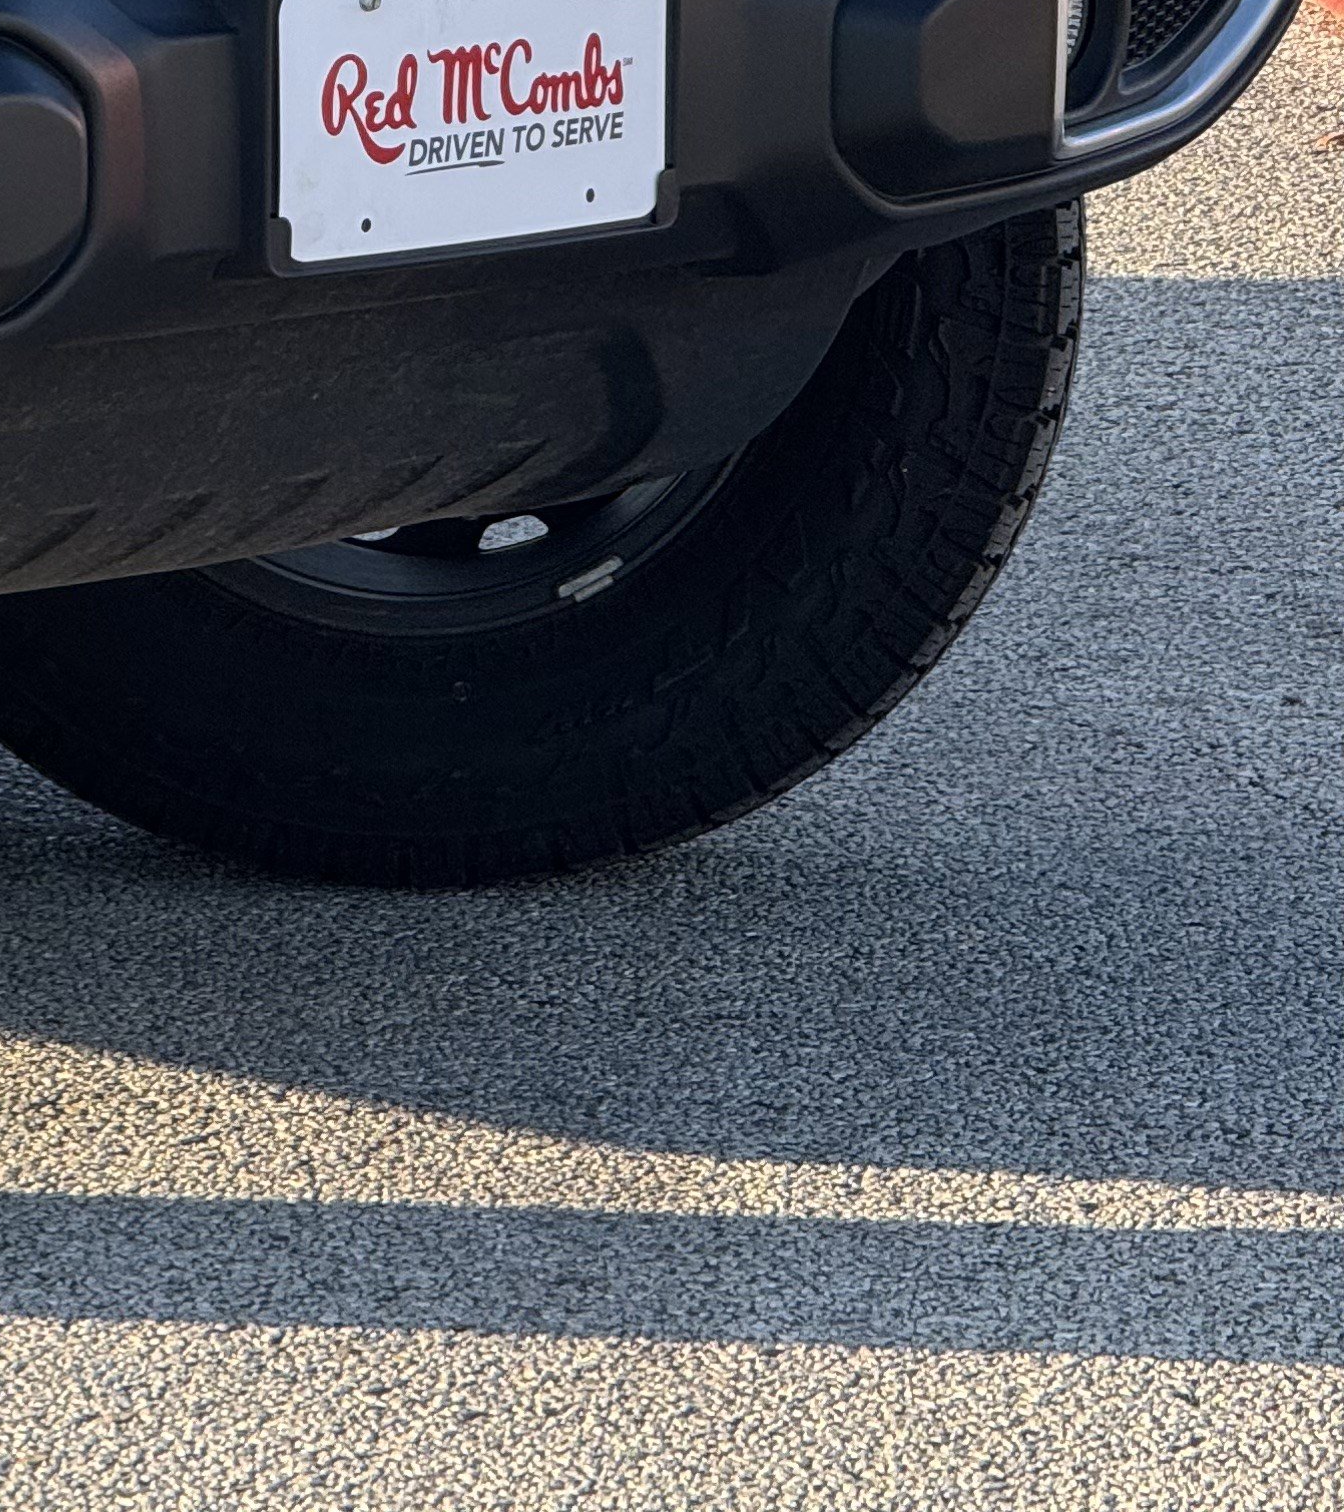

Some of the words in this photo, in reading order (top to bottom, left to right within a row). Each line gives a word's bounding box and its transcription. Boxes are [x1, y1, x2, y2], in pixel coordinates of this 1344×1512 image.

[321, 53, 418, 165] Red
[408, 128, 505, 167] DRIVEN
[512, 123, 546, 154] TO
[550, 111, 625, 148] SERVE
